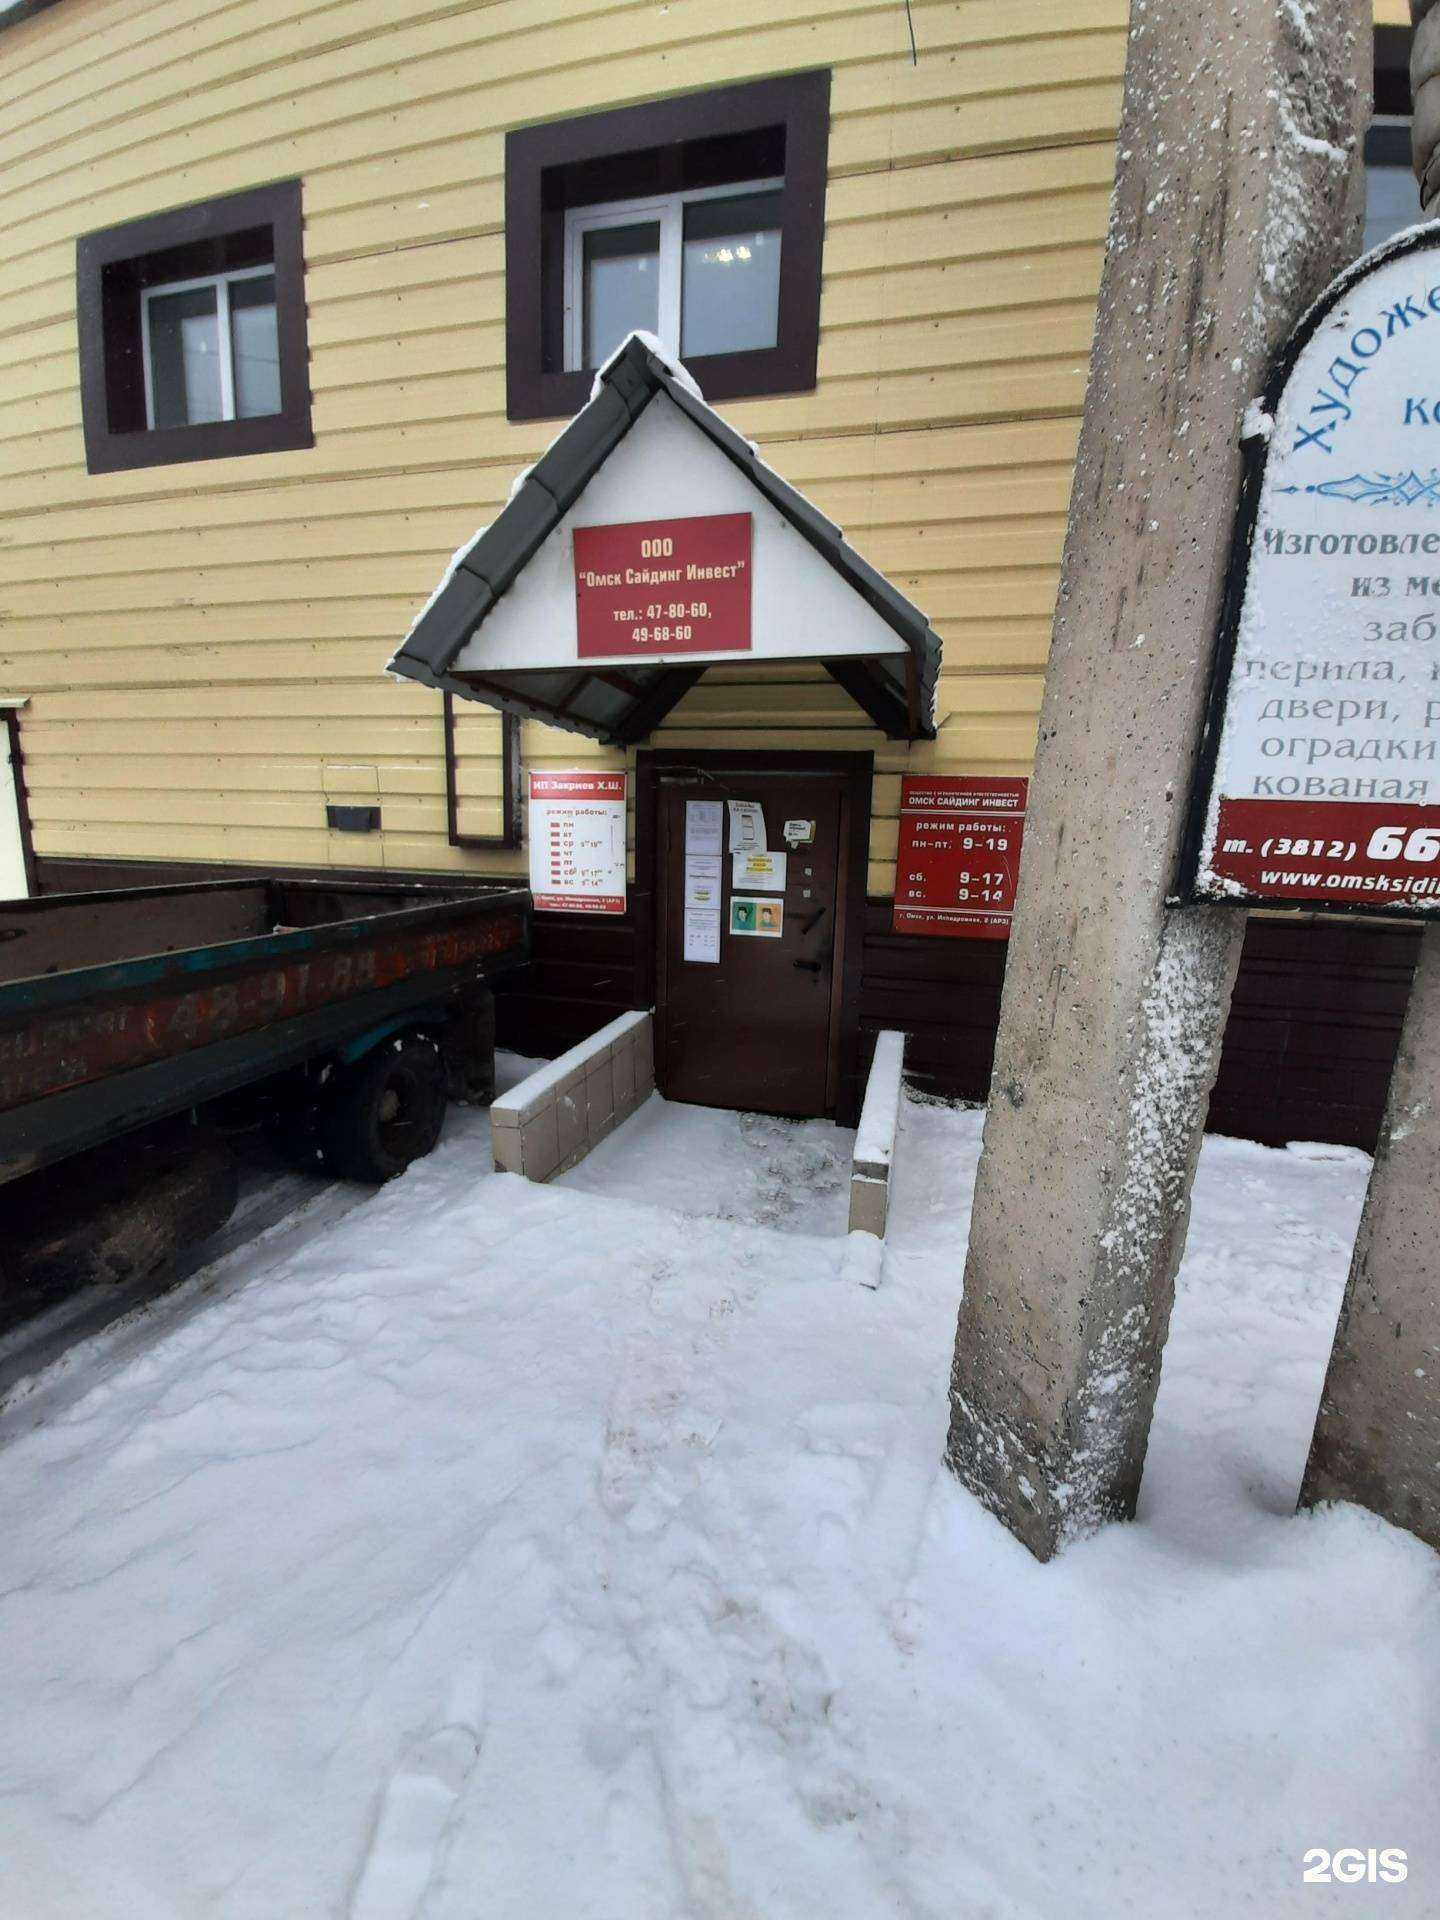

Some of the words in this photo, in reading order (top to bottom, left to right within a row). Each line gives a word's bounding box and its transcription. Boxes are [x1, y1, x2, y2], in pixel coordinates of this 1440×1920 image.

[641, 538, 673, 558] ООО
[626, 568, 682, 585] Сайдинг
[1350, 576, 1391, 597] из
[614, 609, 643, 621] тел.:
[647, 602, 712, 619] 47-80-60,
[632, 626, 692, 642] 49-68-60
[1246, 661, 1406, 687] перила,
[1257, 698, 1399, 727] двери,
[1260, 736, 1437, 765] оградки
[533, 781, 548, 790] ИП
[1252, 775, 1429, 800] кованая
[909, 797, 935, 805] ОМСК
[937, 797, 980, 807] САЙДИНГ
[982, 799, 1019, 807] ИНВЕСТ
[916, 822, 955, 832] режим
[959, 823, 1006, 833] работы:
[963, 838, 1008, 851] 9-19
[1261, 838, 1357, 861] (3812)
[960, 872, 1004, 885] 9-17
[959, 889, 1003, 902] 9-14
